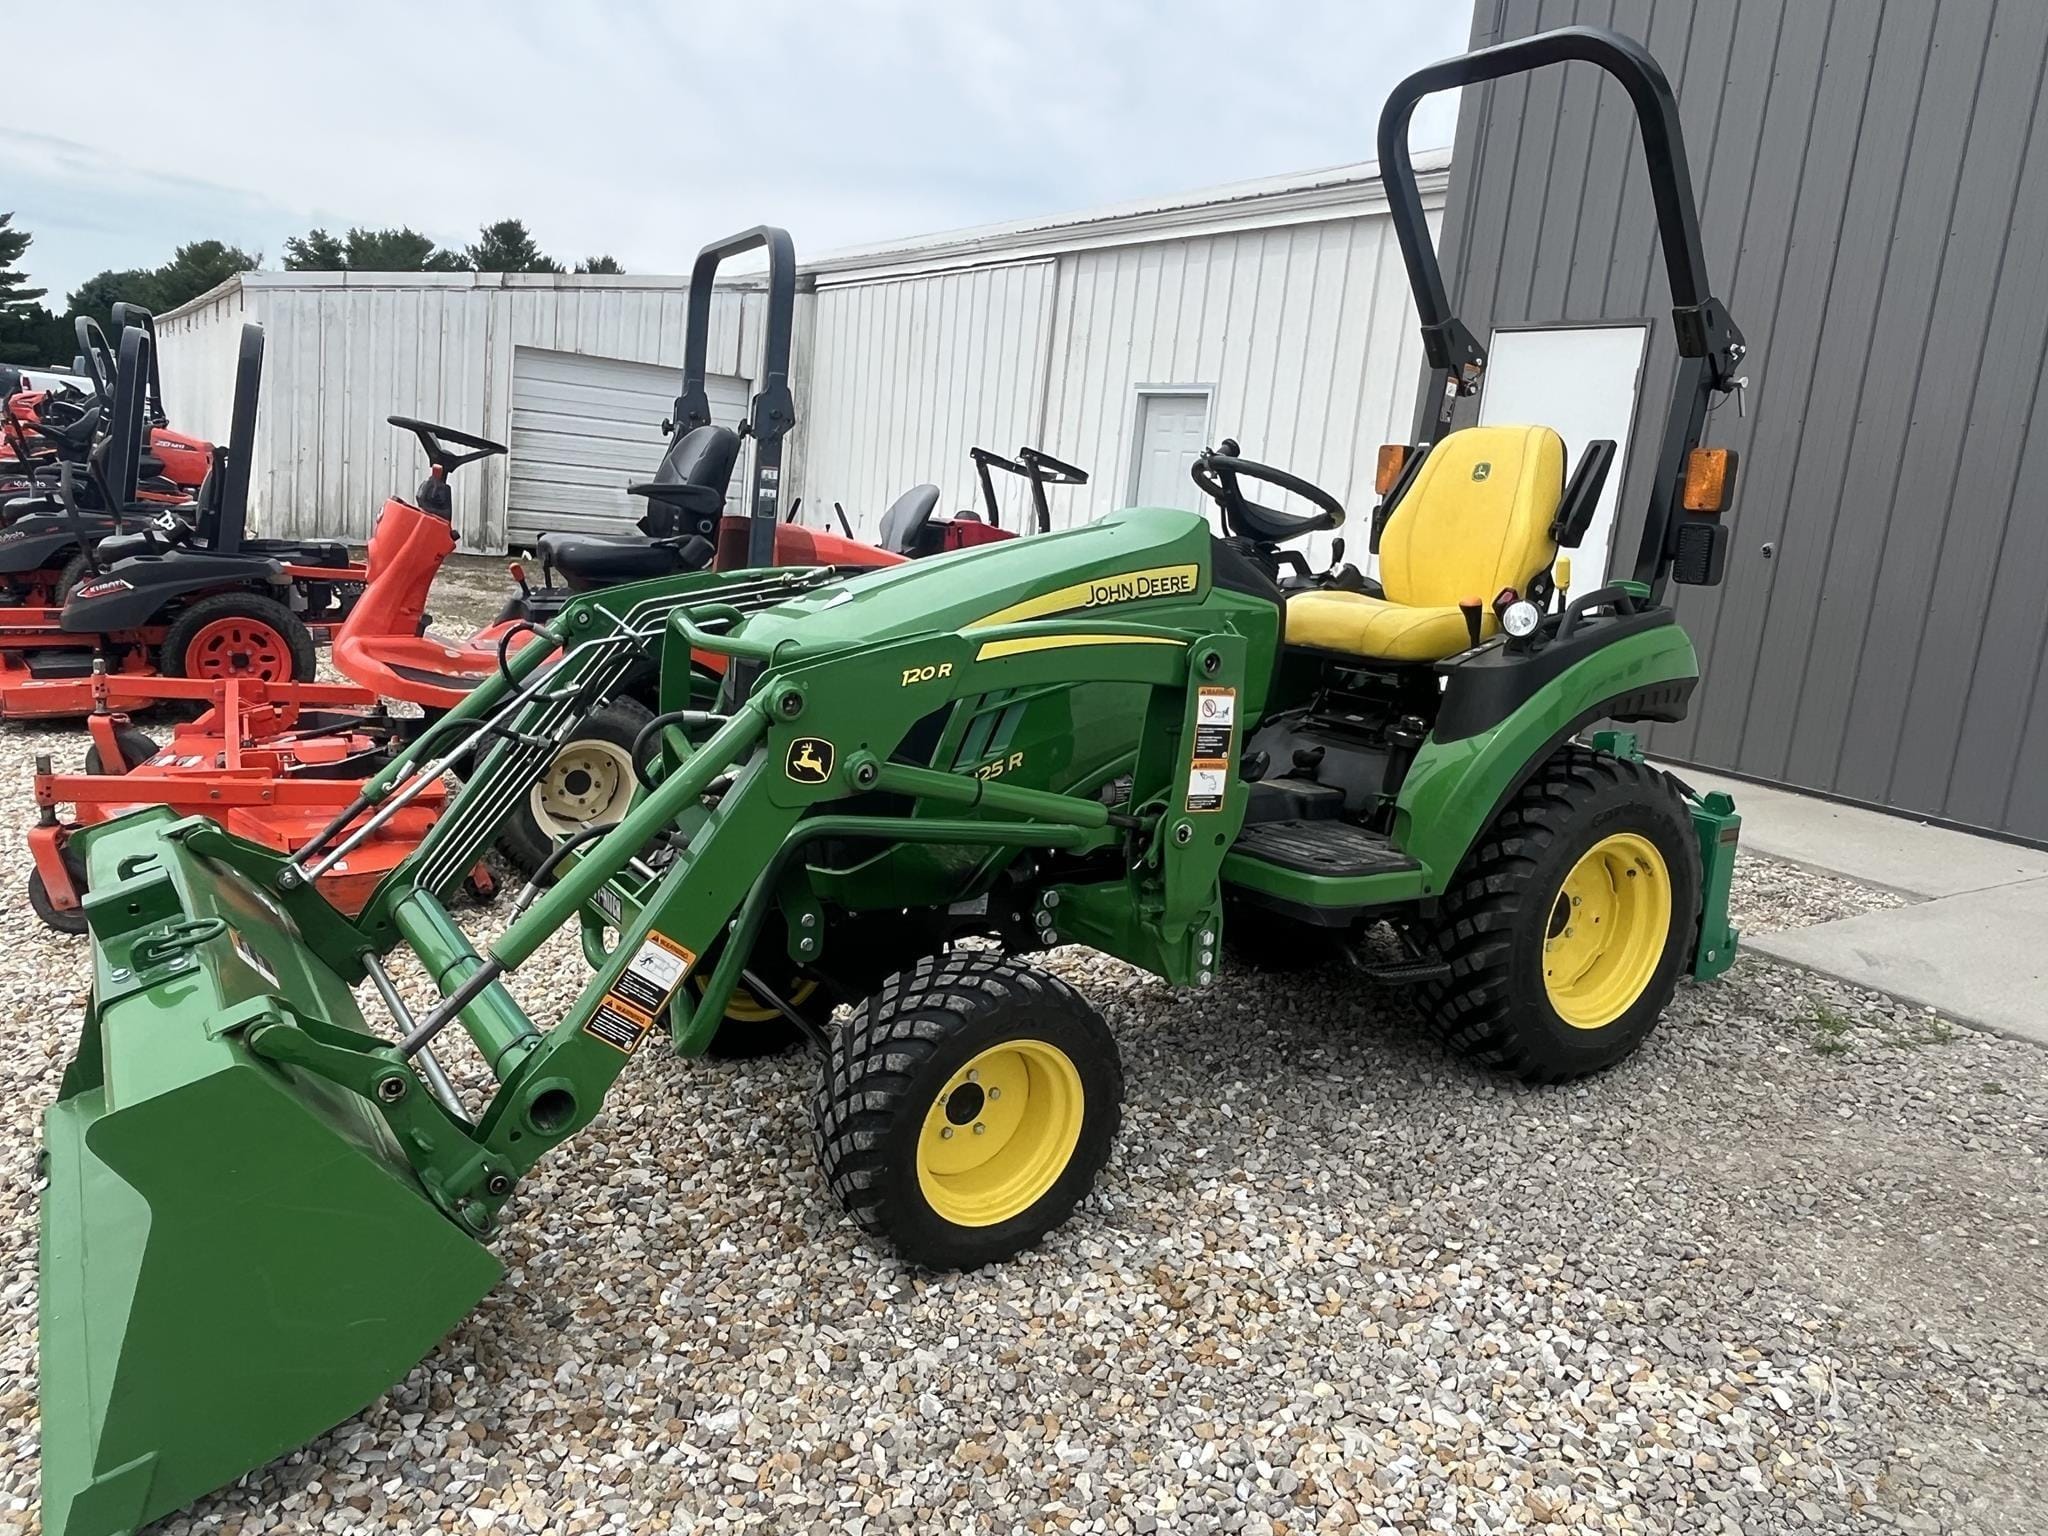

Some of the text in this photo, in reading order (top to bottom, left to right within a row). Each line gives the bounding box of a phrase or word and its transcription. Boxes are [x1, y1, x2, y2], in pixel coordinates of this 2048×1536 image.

[1085, 575, 1190, 605] JOHN DEERE
[901, 662, 953, 687] 120 R
[975, 751, 1024, 781] 25 R
